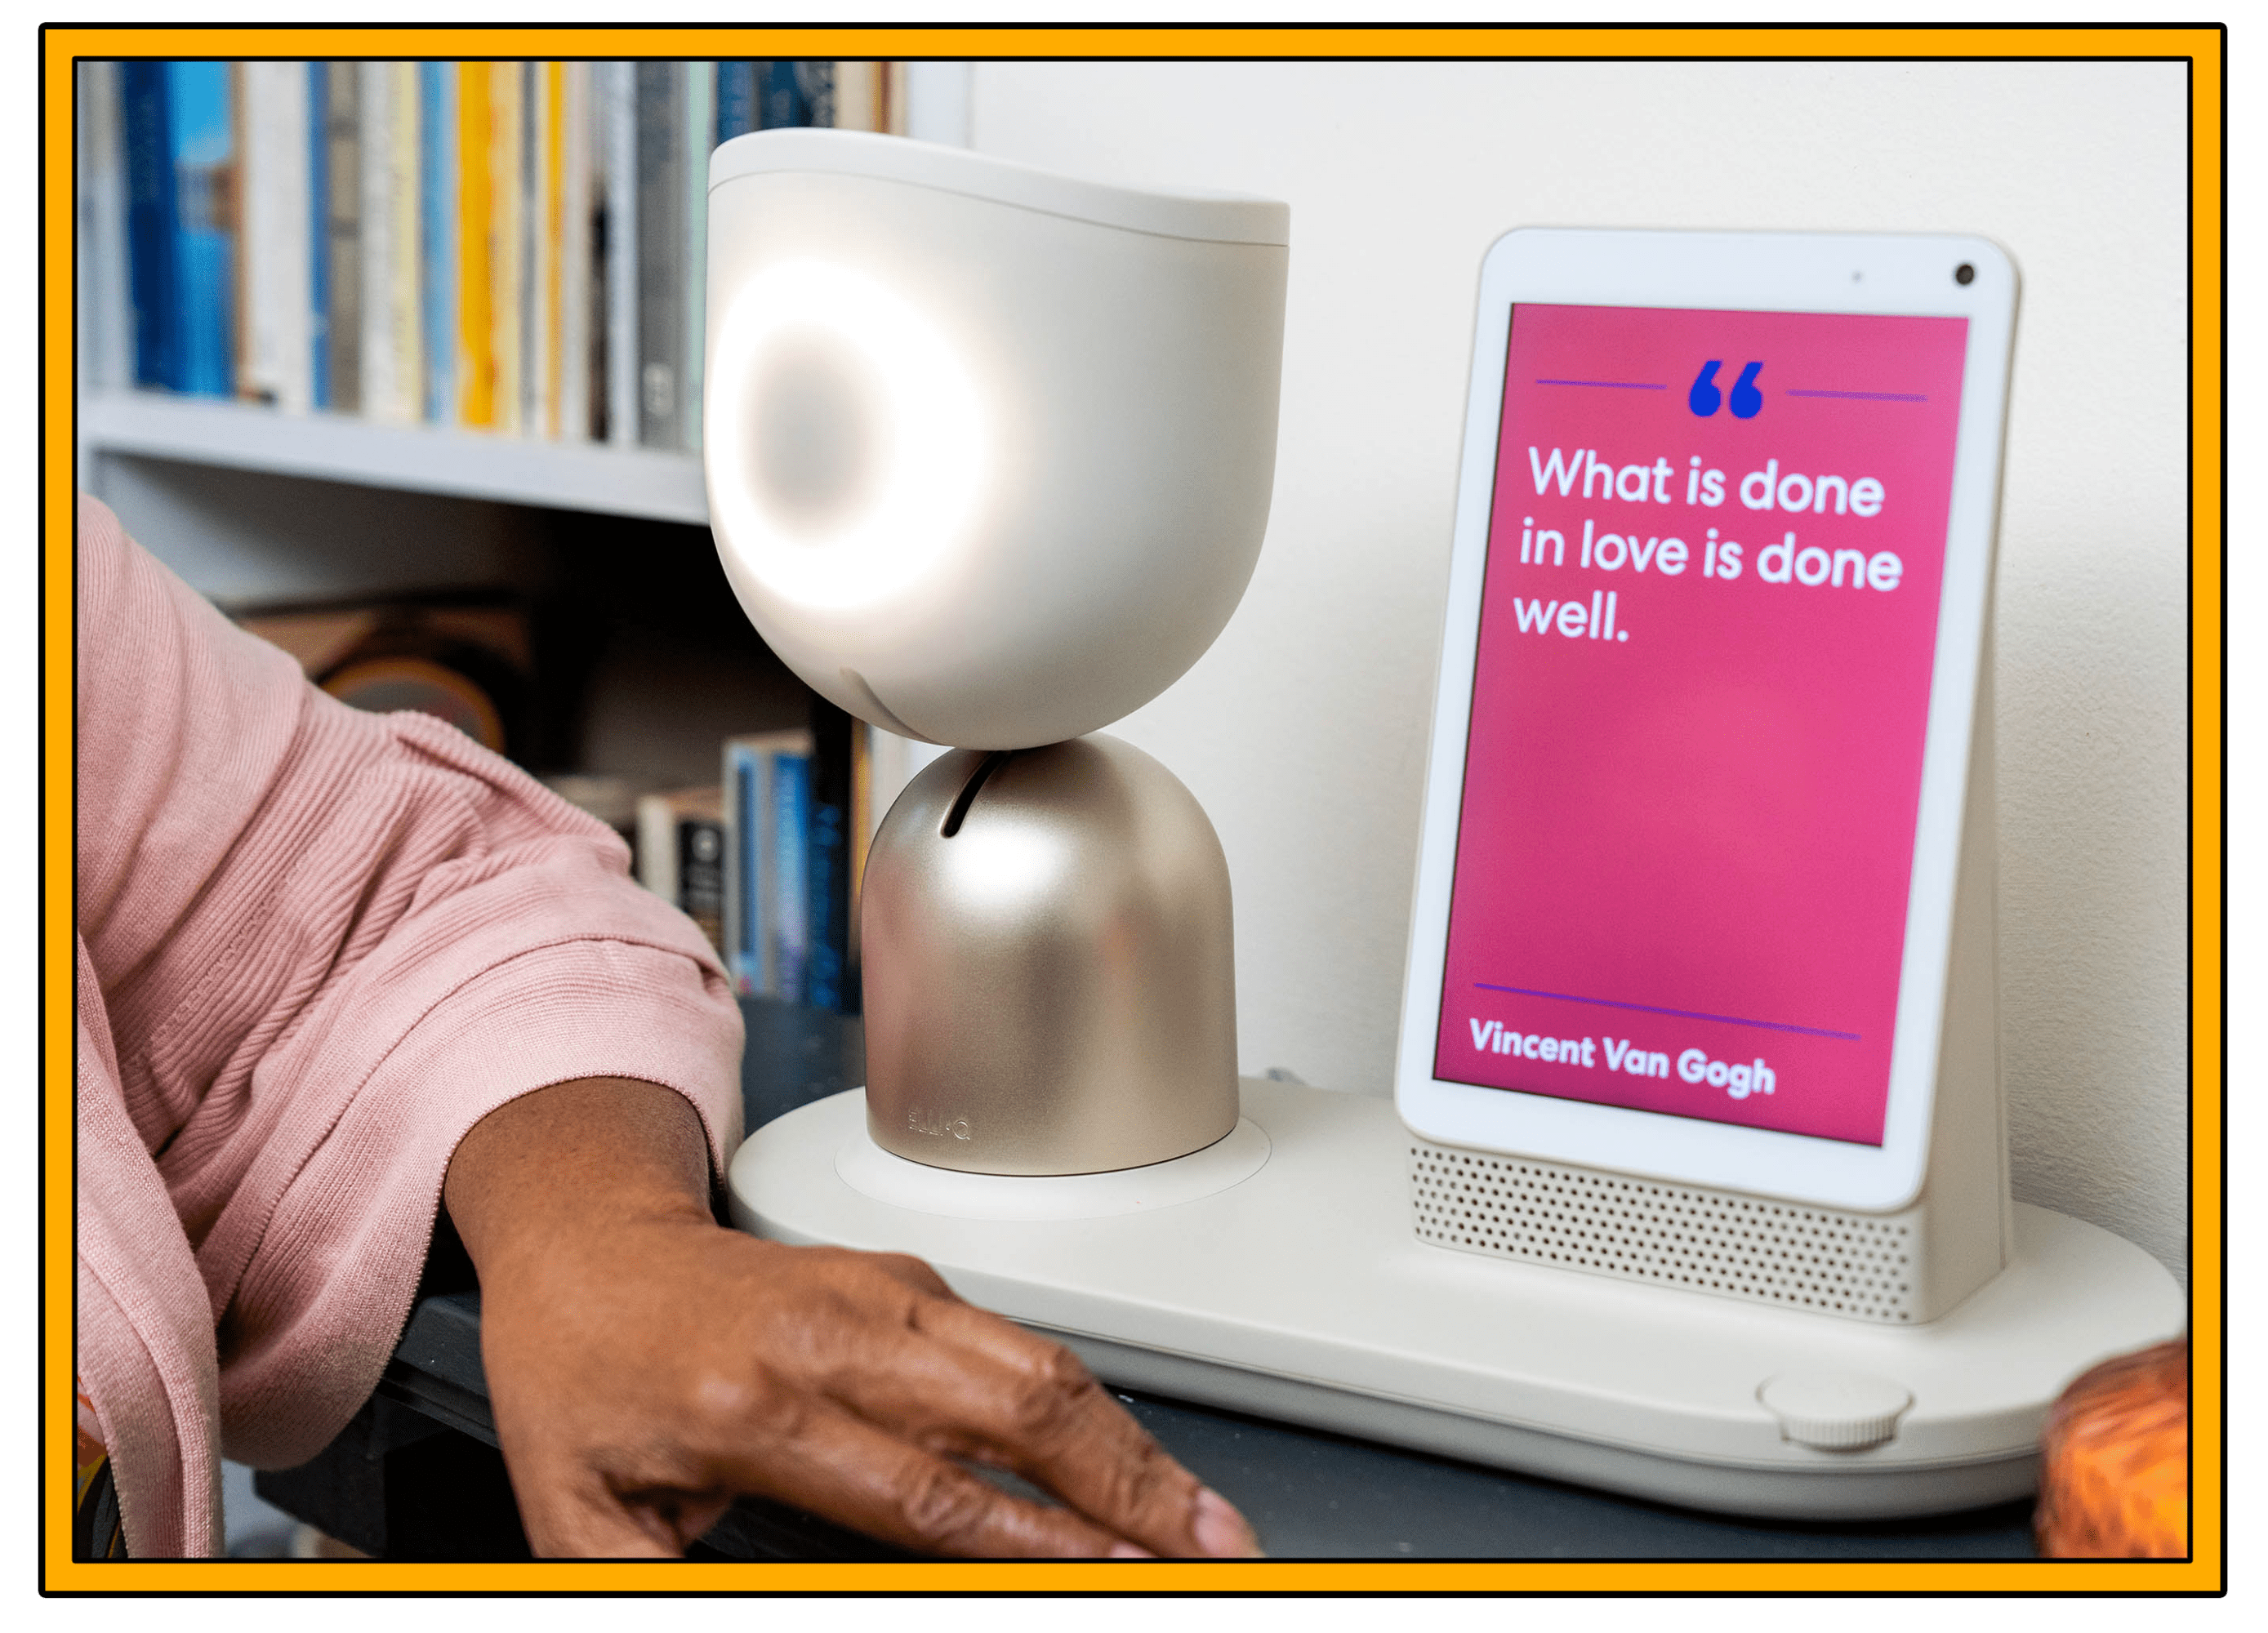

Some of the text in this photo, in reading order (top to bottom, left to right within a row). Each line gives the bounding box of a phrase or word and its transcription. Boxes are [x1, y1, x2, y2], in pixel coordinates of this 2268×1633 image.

[1527, 445, 1885, 518] What is done
[1520, 515, 1903, 592] in love is done
[1513, 589, 1629, 643] well.
[1468, 1017, 1776, 1100] Vincent Van Gogh
